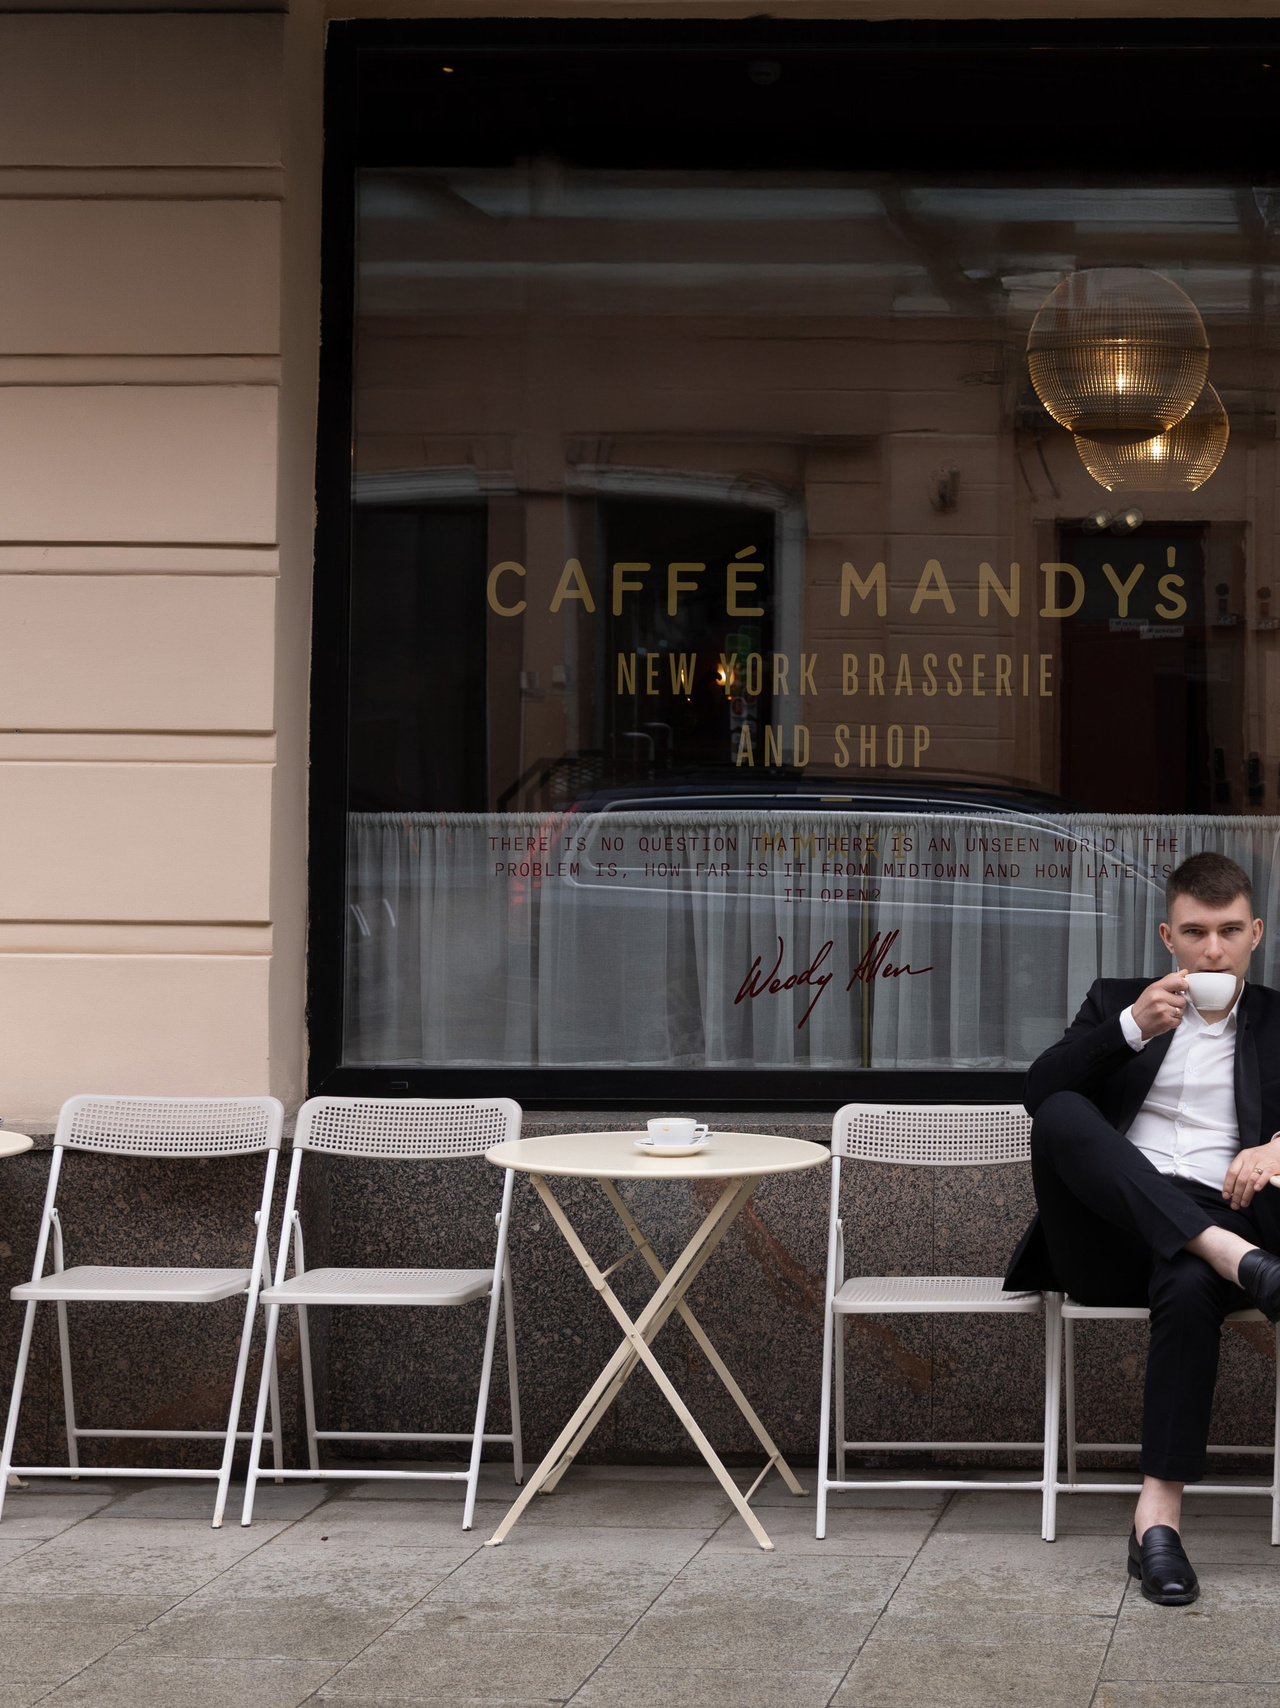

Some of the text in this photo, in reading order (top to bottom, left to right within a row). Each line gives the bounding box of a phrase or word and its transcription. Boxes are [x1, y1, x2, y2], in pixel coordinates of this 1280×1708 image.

[486, 545, 765, 617] CAFFÉ
[617, 653, 1053, 696] NEW YORK BRASSERIE
[736, 725, 931, 768] AND SHOP
[488, 837, 549, 852] THERE
[564, 837, 587, 852] IS
[601, 837, 624, 852] NO
[638, 837, 738, 853] QUESTION
[752, 837, 801, 852] THAT
[814, 837, 875, 852] THERE
[891, 837, 913, 852] IS
[928, 838, 951, 852] AN
[966, 838, 1040, 853] UNSEEN
[1143, 838, 1179, 853] THE
[495, 862, 1173, 879] PROBLEM IS, HOW FAR IS IT FROM MIDTOWN AND HOW LATE IS
[784, 888, 882, 904] IT OPEN?
